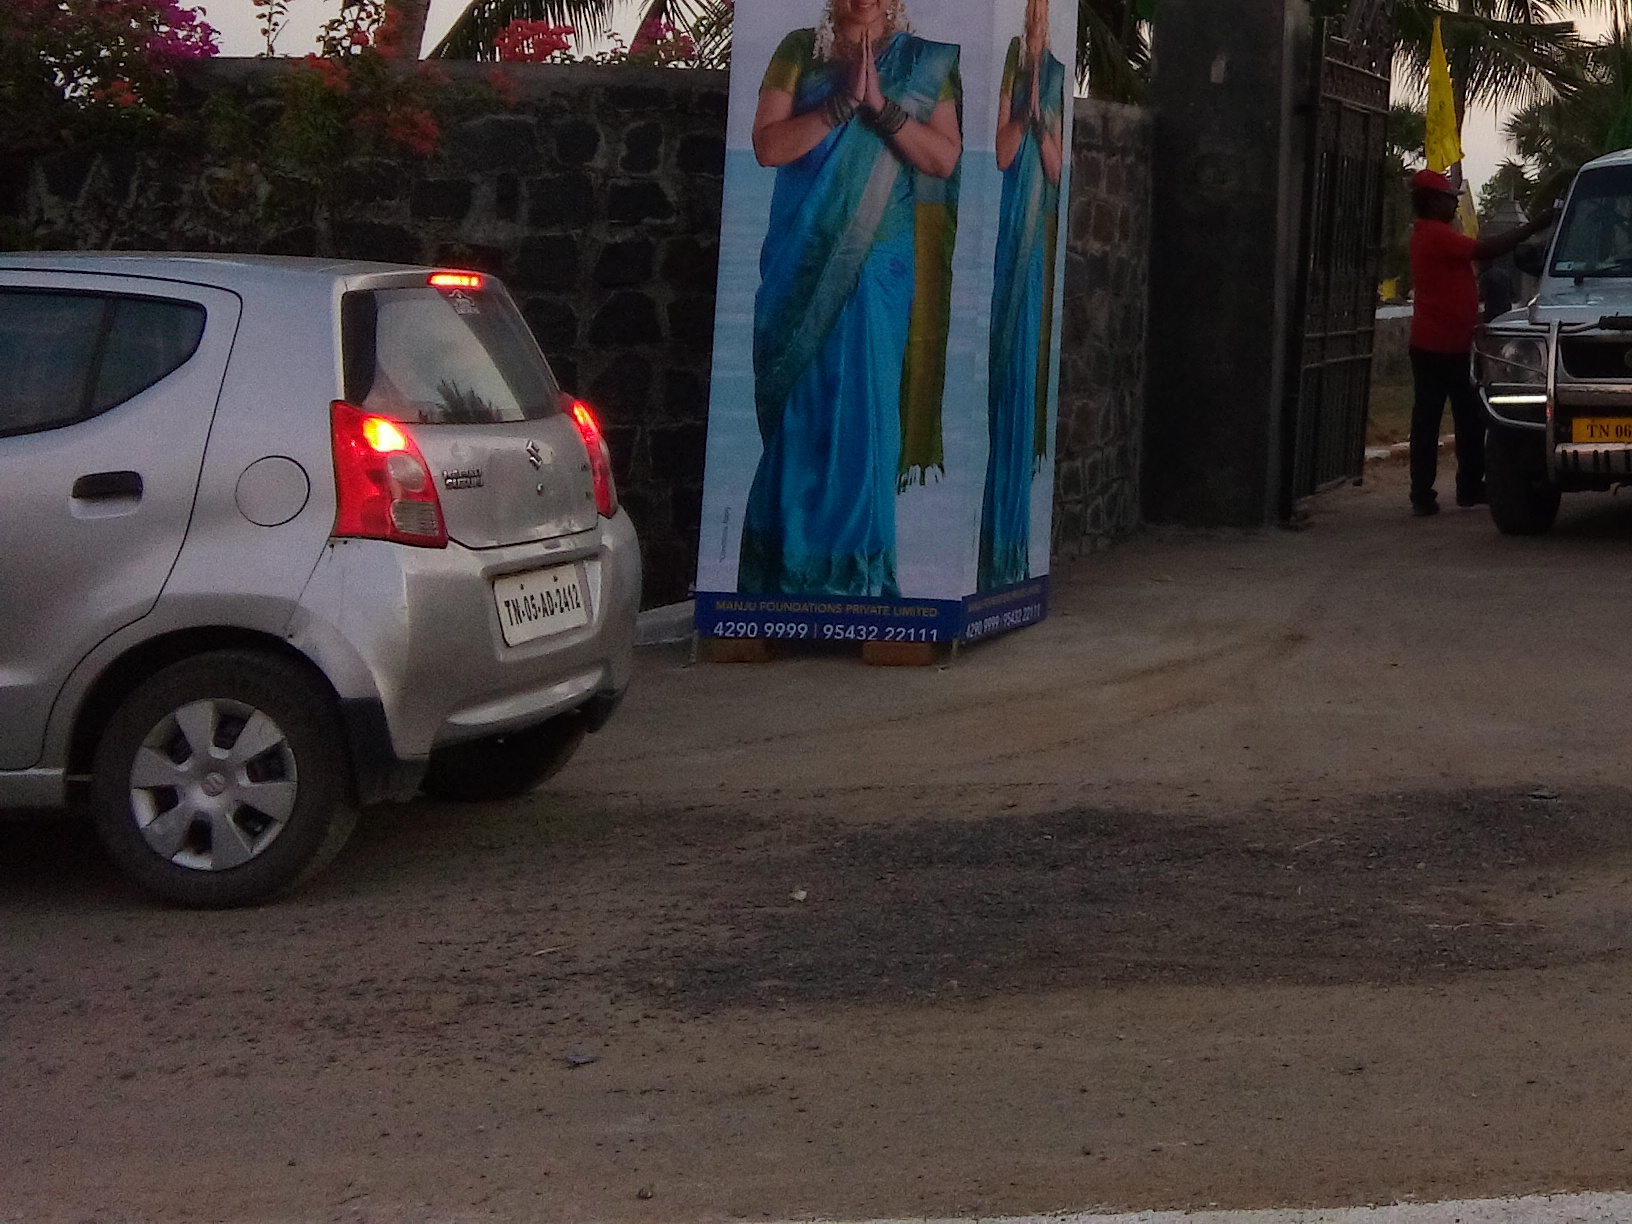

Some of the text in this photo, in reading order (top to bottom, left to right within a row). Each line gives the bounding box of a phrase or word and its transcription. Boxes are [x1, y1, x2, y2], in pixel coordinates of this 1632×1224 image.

[1586, 424, 1609, 438] TN
[716, 601, 938, 618] MANJU FOUNDATIONS PRIVATE LIMITED
[713, 621, 938, 642] 4290 9999 95432 22111
